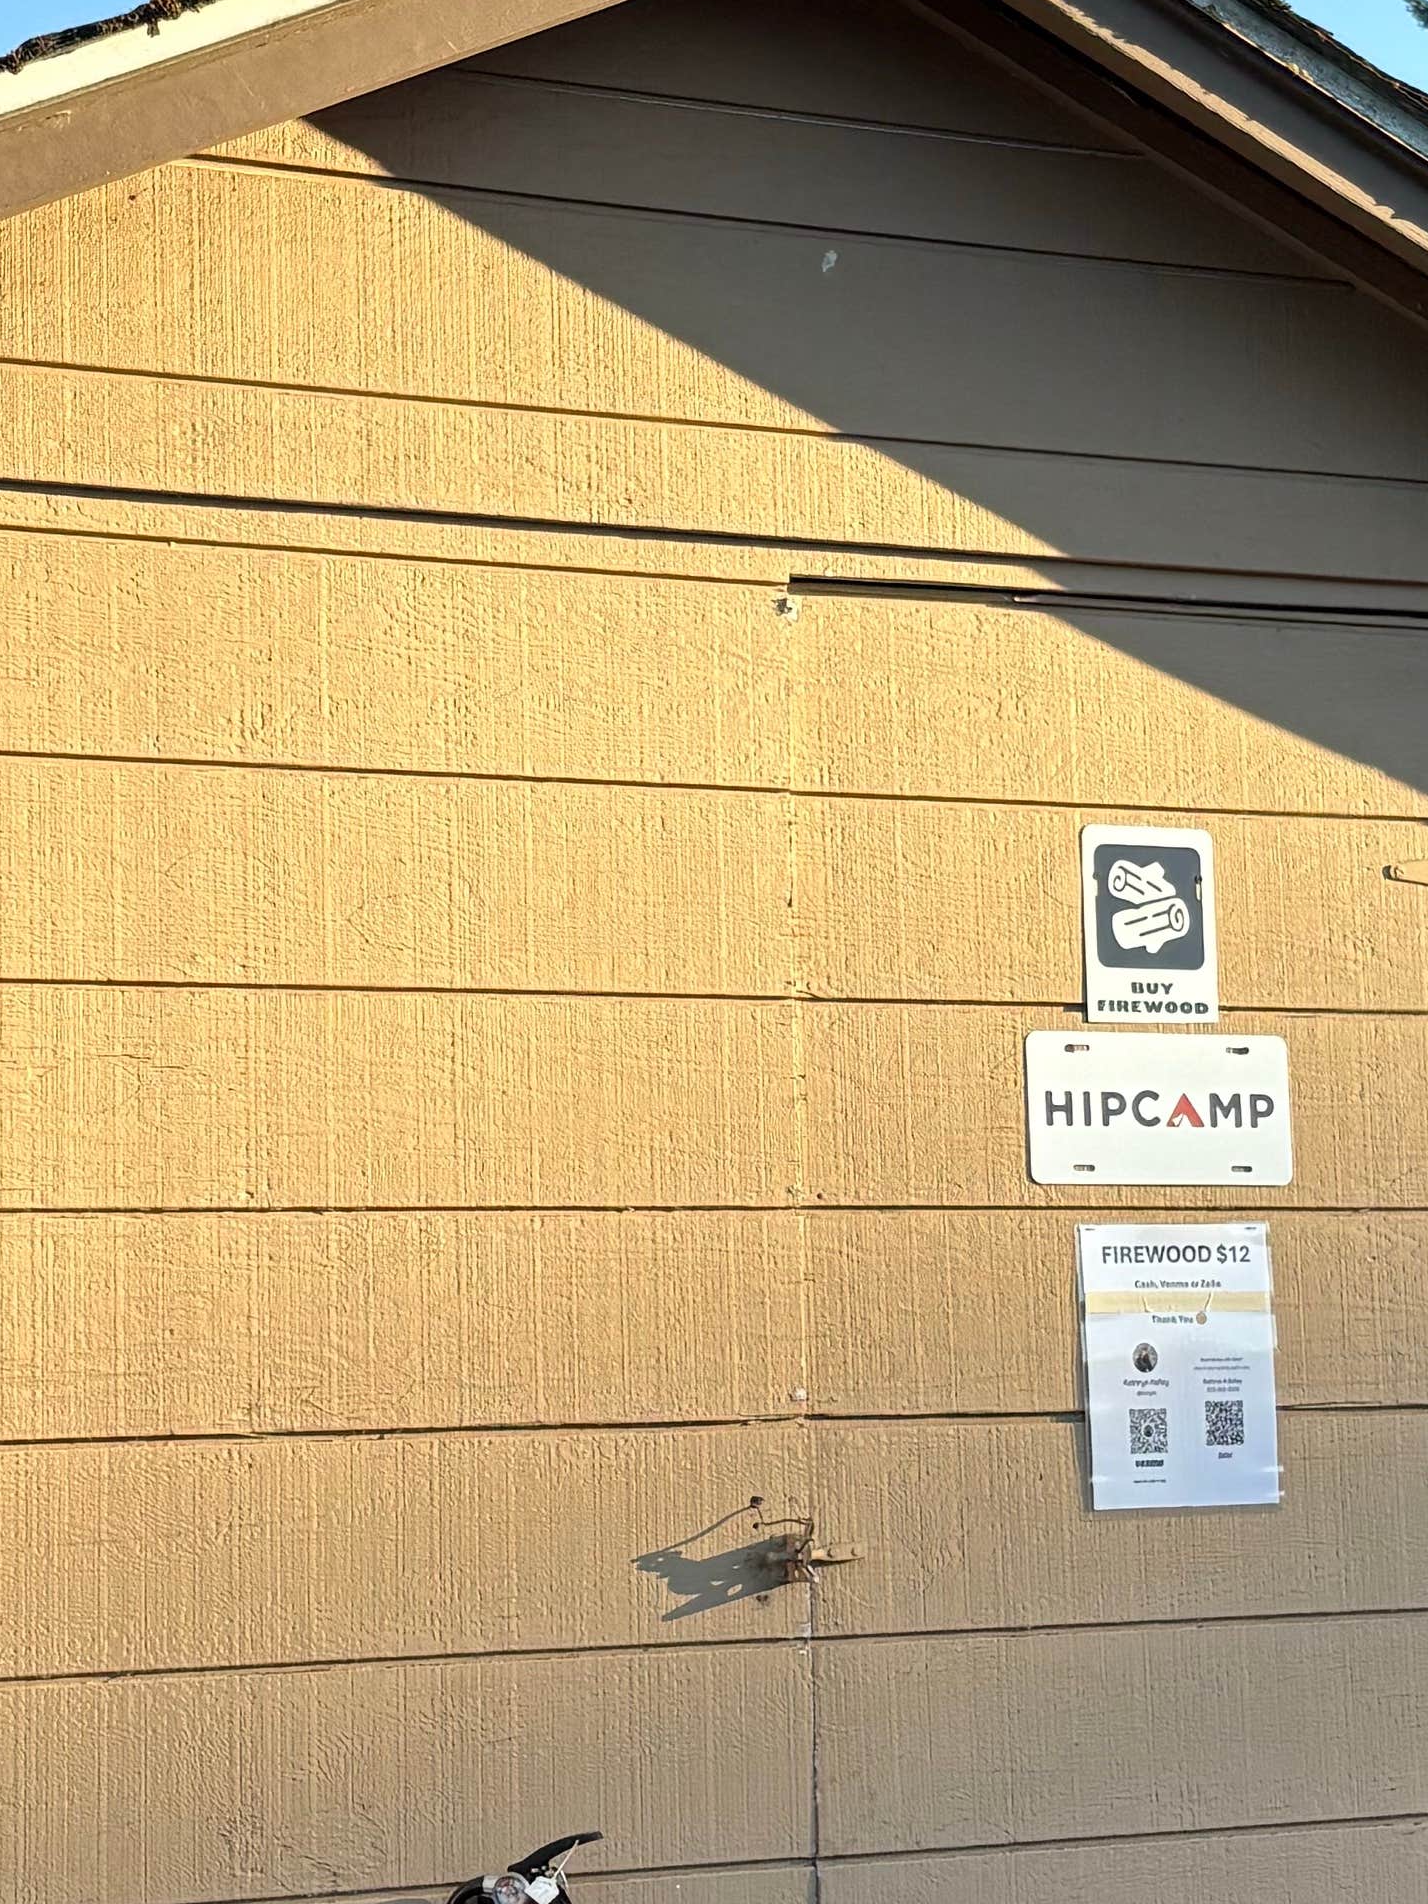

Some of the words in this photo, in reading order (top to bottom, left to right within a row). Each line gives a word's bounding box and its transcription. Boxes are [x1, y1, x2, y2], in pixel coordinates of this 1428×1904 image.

[1131, 982, 1173, 995] BUY
[1097, 1000, 1209, 1014] FIREWOOD
[1044, 1089, 1274, 1128] HIPCAMP
[1102, 1245, 1211, 1264] FIREWOOD
[1216, 1243, 1251, 1264] $12
